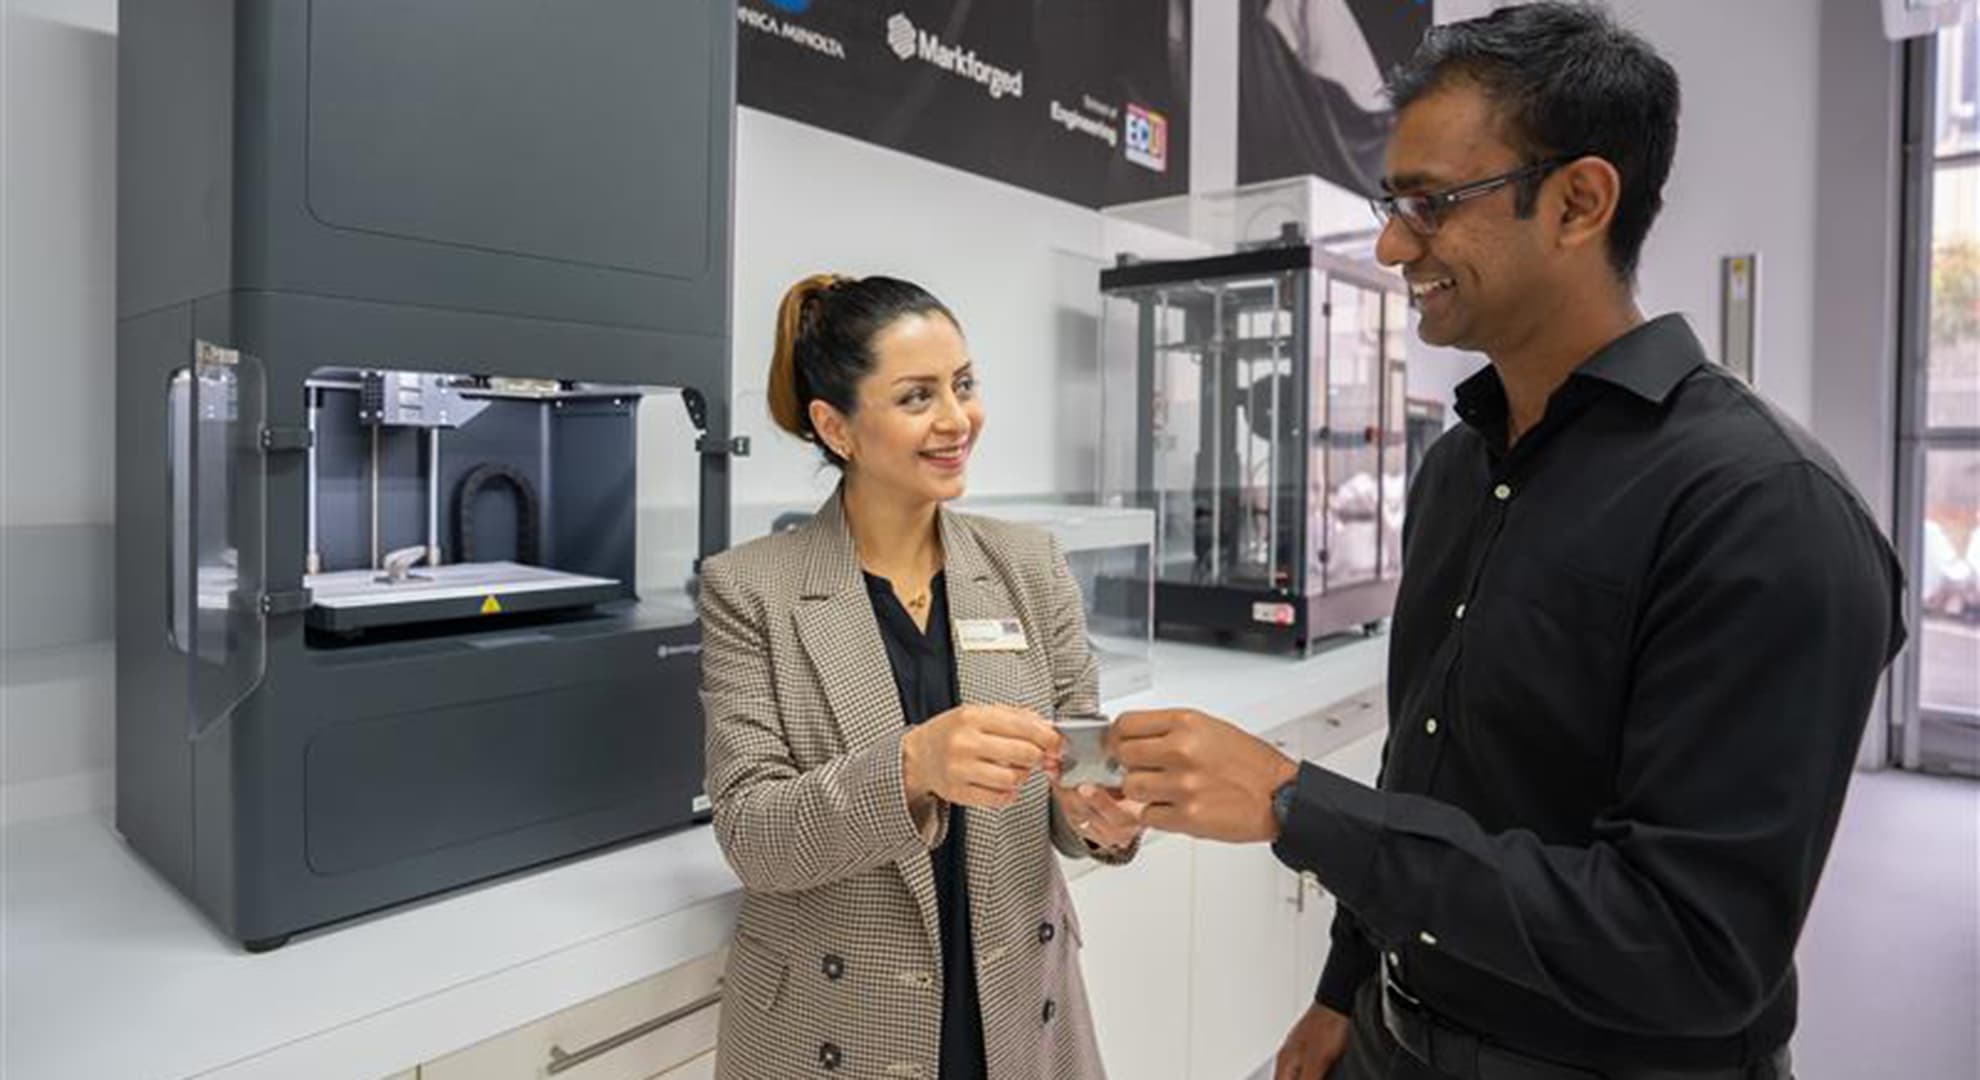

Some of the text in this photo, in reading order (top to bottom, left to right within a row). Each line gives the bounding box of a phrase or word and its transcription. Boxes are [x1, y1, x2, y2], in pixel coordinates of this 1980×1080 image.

[781, 21, 846, 59] MINOLTA
[918, 29, 1023, 99] Markforged
[1050, 100, 1117, 147] Engineering
